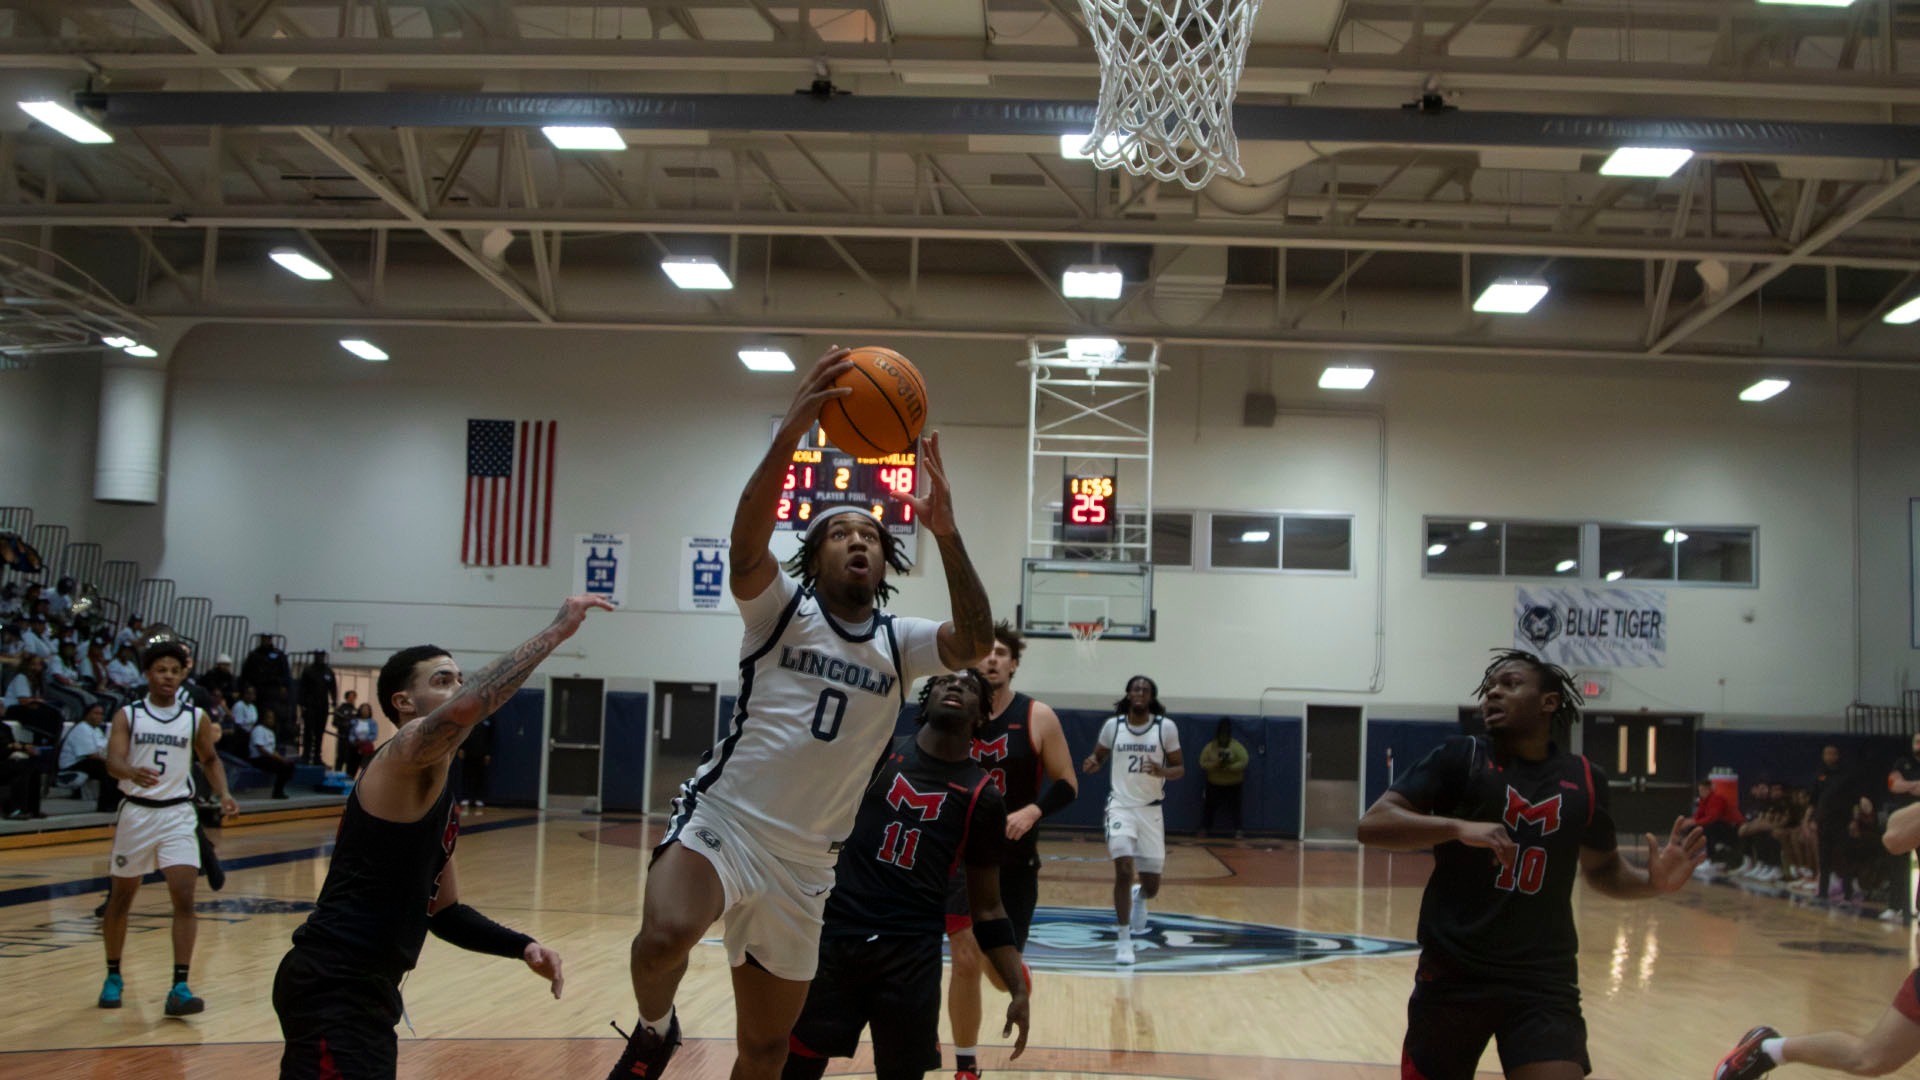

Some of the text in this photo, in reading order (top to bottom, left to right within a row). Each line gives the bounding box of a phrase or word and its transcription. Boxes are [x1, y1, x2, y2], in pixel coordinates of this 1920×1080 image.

[834, 467, 850, 489] 2
[880, 467, 913, 492] 48
[777, 498, 791, 519] 2
[798, 503, 811, 520] 2
[903, 504, 911, 521] 1
[1072, 494, 1106, 523] 25
[1565, 608, 1662, 639] BLUE TIGER
[778, 644, 896, 697] LINCOLN
[811, 687, 848, 742] 0
[134, 732, 189, 749] LINCOLN
[970, 733, 1009, 762] M
[1117, 743, 1158, 752] LINCOLN
[154, 749, 168, 776] 5
[1128, 755, 1144, 774] 21
[886, 772, 948, 822] M
[1503, 784, 1562, 837] M
[876, 821, 922, 871] 11
[1494, 843, 1548, 896] 10
